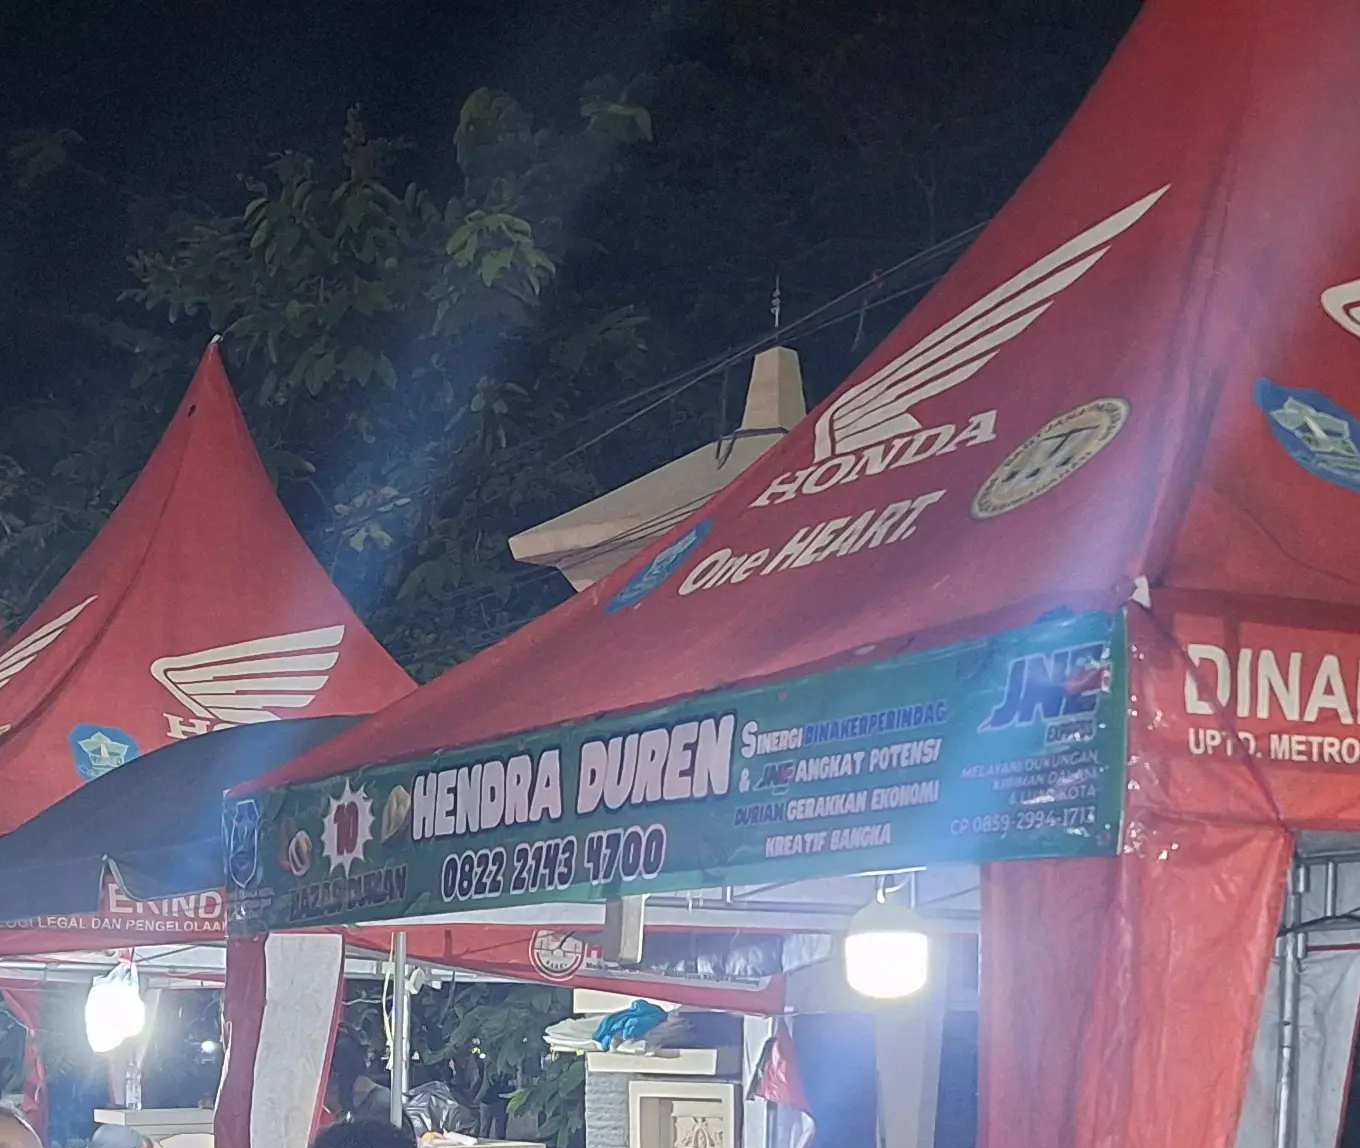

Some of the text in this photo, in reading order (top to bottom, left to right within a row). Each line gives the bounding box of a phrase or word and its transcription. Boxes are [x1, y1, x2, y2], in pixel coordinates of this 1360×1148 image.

[748, 410, 997, 508] HONDA
[678, 489, 947, 596] One HEART.
[977, 641, 1112, 733] JNE
[804, 699, 949, 746] DINAKERPERINDAG
[411, 713, 736, 842] HENDRA DUREN
[739, 768, 750, 793] &
[794, 751, 866, 783] ANGKAT
[869, 738, 942, 772] POTENSI
[333, 800, 360, 857] 10
[734, 780, 940, 827] DURIAN GERAKKAN EKONOMI
[950, 818, 969, 836] CP
[441, 823, 667, 903] 0822 2143 4700
[765, 823, 892, 858] KREATIF BANGKA
[38, 915, 86, 930] LEGAL
[91, 918, 122, 931] DAN
